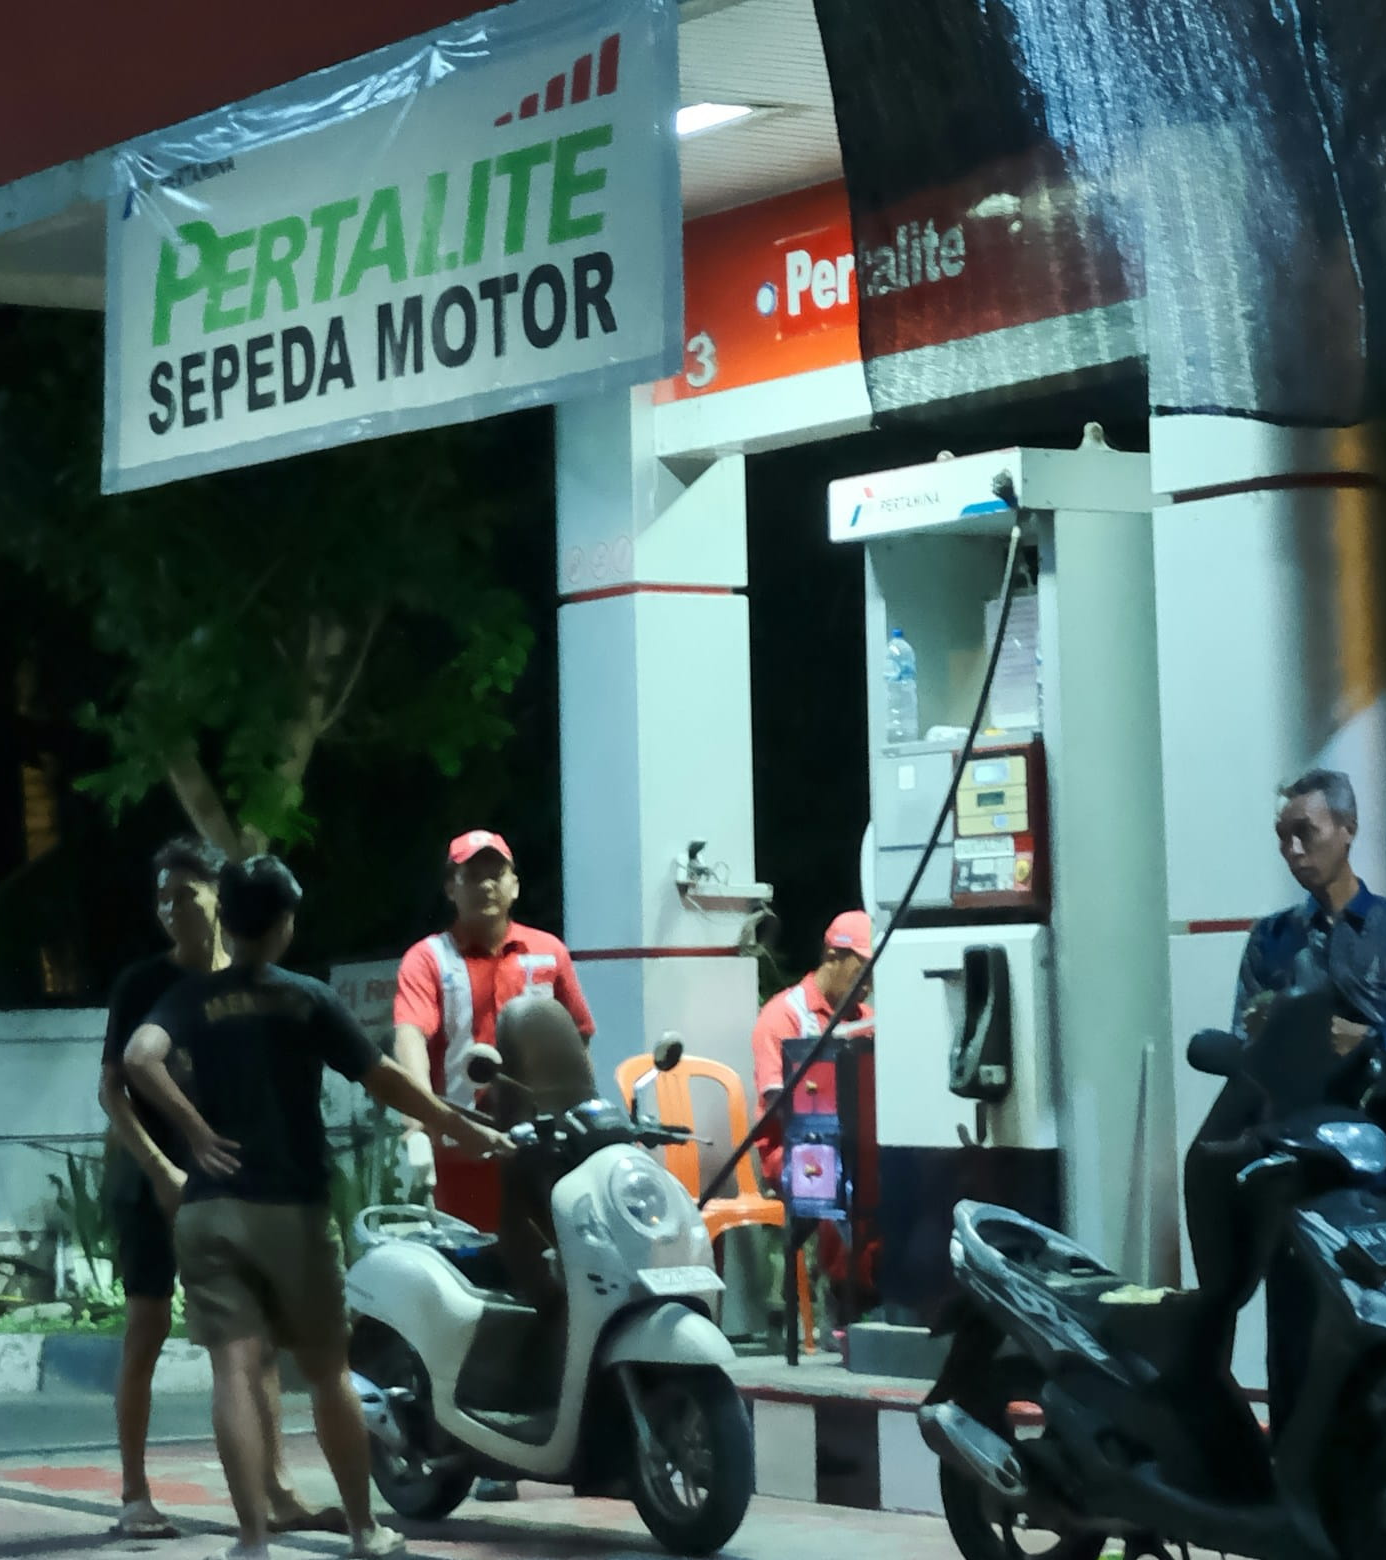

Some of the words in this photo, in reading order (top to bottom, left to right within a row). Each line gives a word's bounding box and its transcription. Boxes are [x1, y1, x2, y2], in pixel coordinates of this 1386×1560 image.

[152, 124, 613, 346] PERTALITE
[148, 316, 356, 436] SEPEDA
[377, 251, 617, 381] MOTOR
[686, 331, 718, 388] 3
